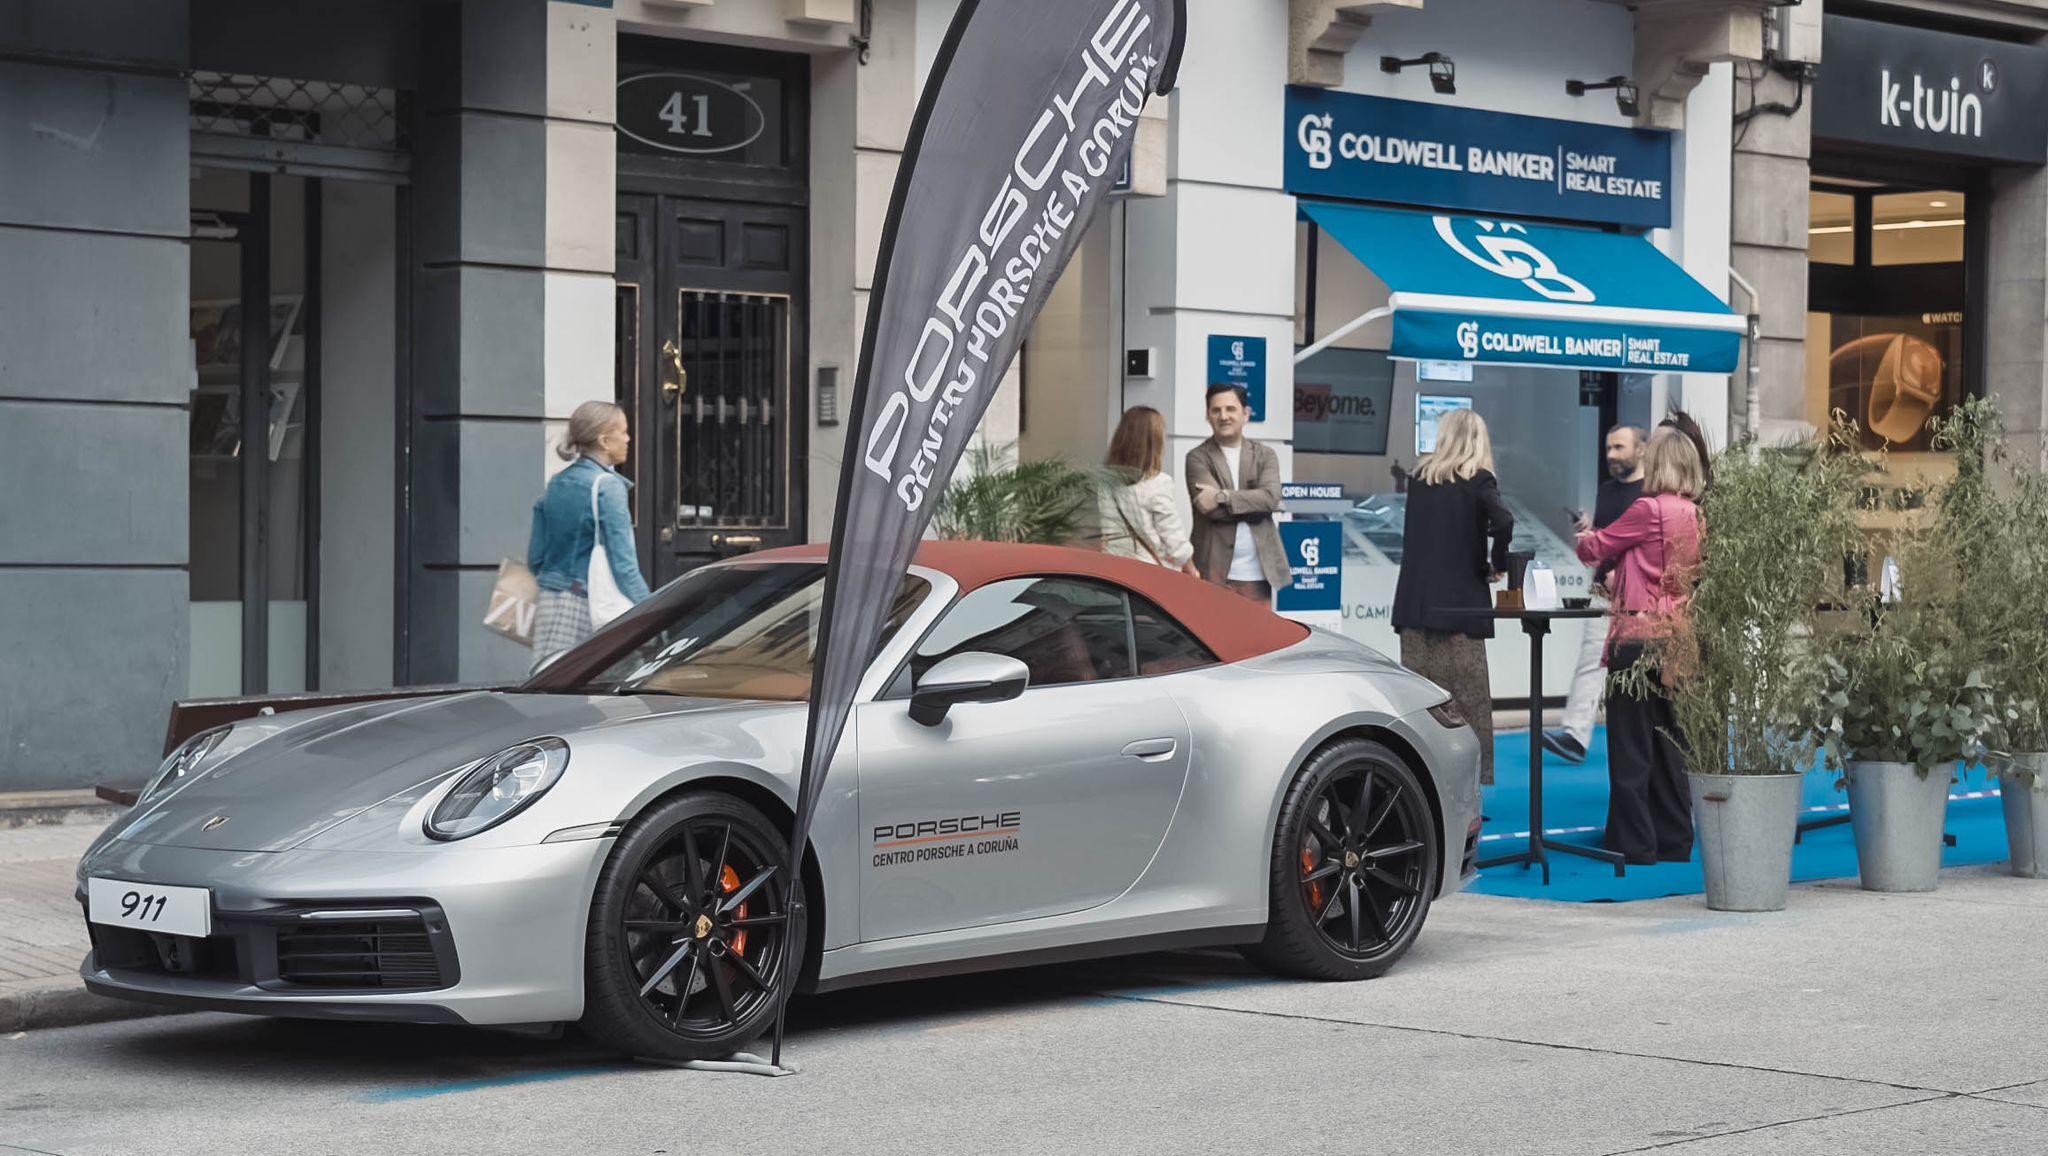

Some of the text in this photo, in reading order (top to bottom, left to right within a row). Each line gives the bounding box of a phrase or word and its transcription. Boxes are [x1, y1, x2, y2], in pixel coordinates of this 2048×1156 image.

[658, 91, 713, 137] 41
[1881, 69, 1981, 137] k-tuin
[1339, 132, 1554, 181] COLDWELL BANKER
[1566, 152, 1616, 174] SMART
[1566, 172, 1662, 199] REAL ESTATE
[865, 0, 1151, 483] PORSCHE
[1482, 332, 1622, 357] COLDWELL BANKER
[1628, 337, 1660, 351] SMART
[1628, 351, 1689, 366] REAL ESTATE
[1282, 487, 1341, 498] OPEN HOUSE
[874, 811, 1021, 842] PORSCHE
[873, 836, 1019, 867] CENTRO PORSCHE A CORUÑA
[121, 891, 167, 921] 911
